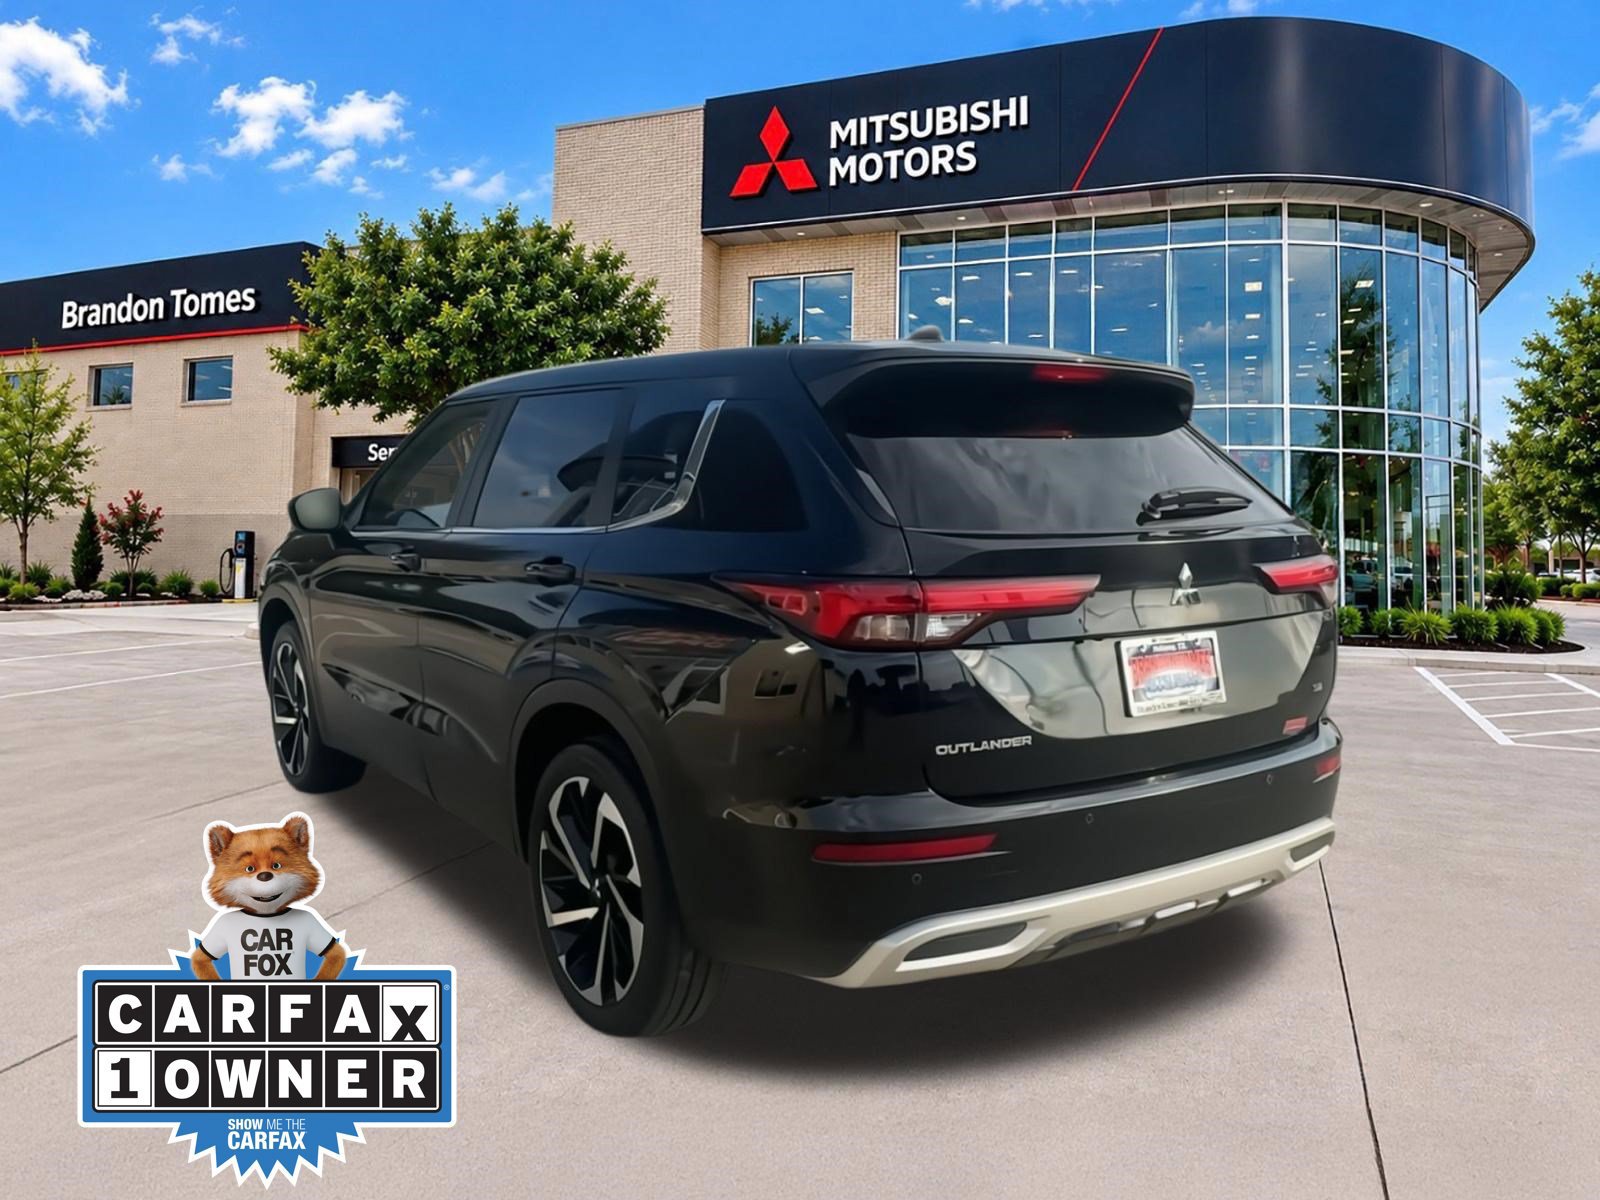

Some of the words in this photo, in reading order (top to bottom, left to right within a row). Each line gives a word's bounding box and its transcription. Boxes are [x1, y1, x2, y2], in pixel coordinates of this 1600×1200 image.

[829, 95, 1029, 150] MITSUBISHI
[829, 141, 978, 187] MOTORS
[61, 292, 165, 330] Brandon
[170, 287, 256, 319] Tomes
[935, 735, 1032, 755] OUTLANDER
